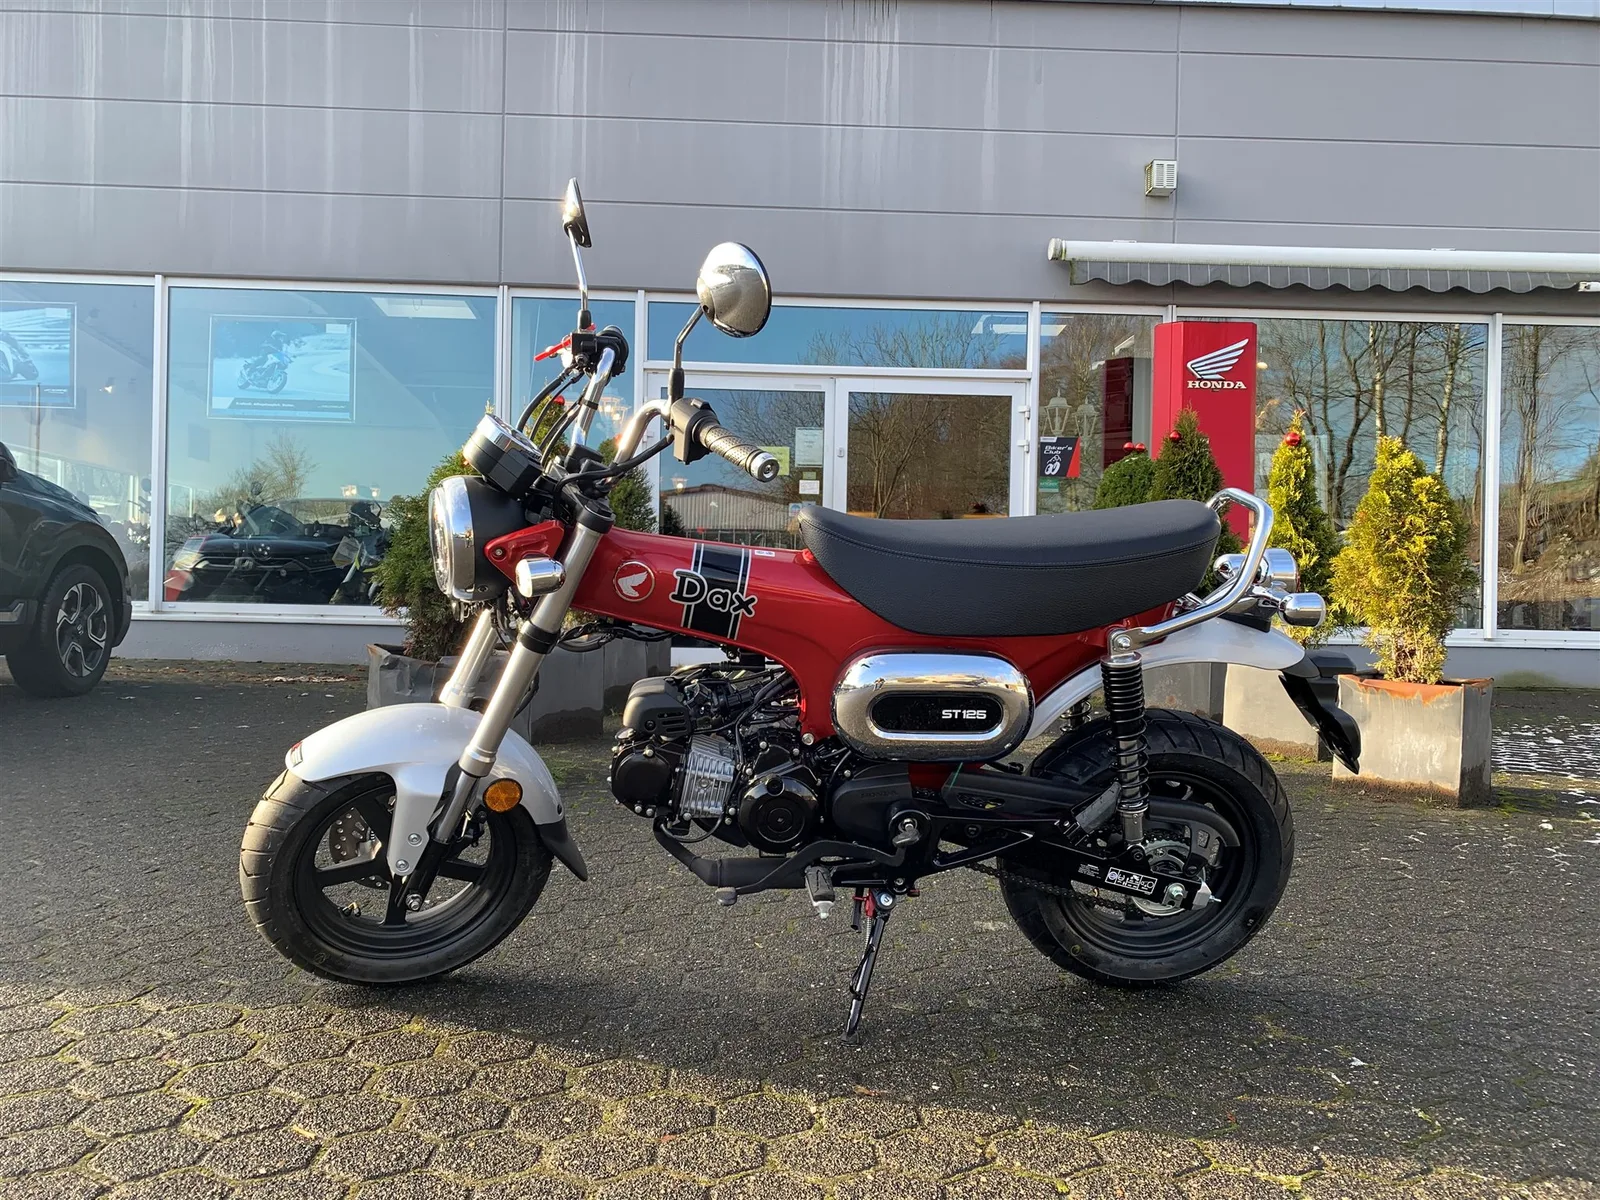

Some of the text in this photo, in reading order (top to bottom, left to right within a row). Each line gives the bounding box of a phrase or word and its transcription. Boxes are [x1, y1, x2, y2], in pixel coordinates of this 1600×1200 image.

[1187, 380, 1247, 389] HONDA
[669, 568, 758, 617] Dax
[941, 709, 987, 719] ST125
